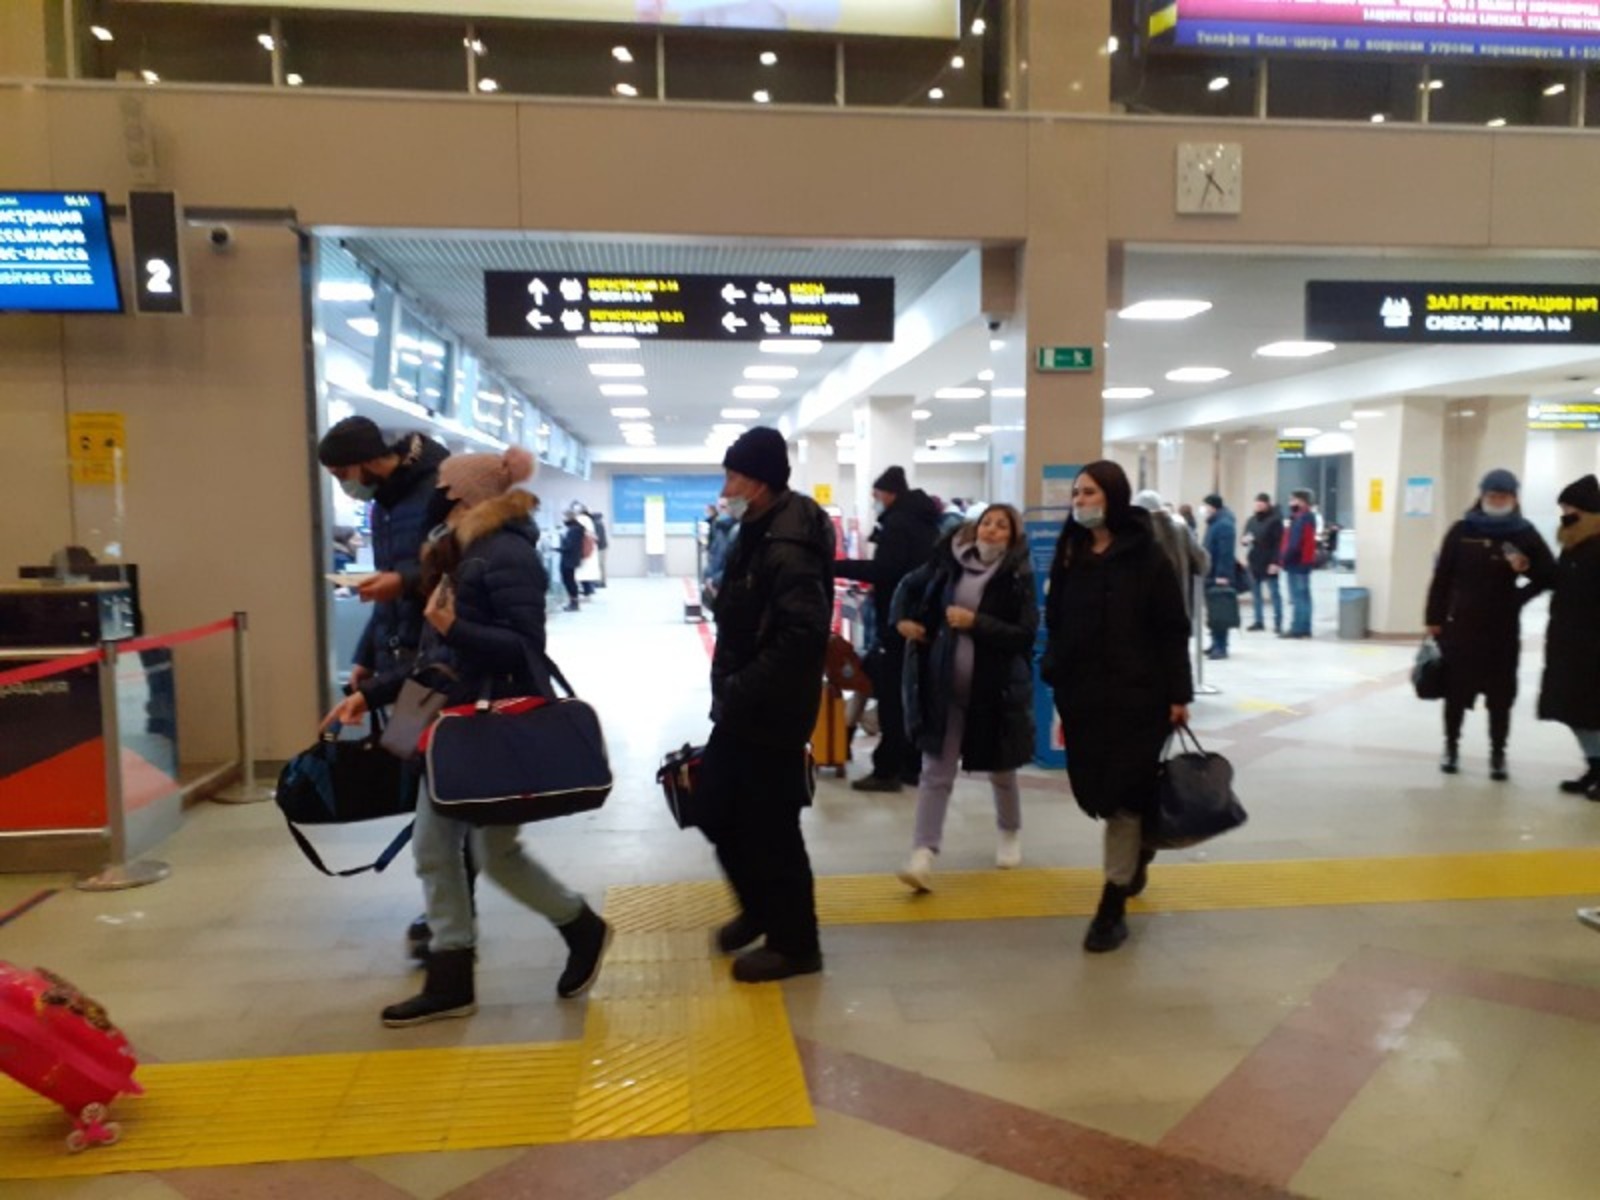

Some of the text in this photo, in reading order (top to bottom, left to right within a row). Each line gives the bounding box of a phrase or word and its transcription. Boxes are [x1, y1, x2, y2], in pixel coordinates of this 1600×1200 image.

[53, 269, 94, 284] class
[146, 259, 172, 293] 2
[1426, 294, 1459, 310] ЗАЛ
[1461, 295, 1573, 312] РЕГИСТРАЦИИ
[1425, 315, 1500, 330] CHECK-IN
[1502, 315, 1545, 331] AREA
